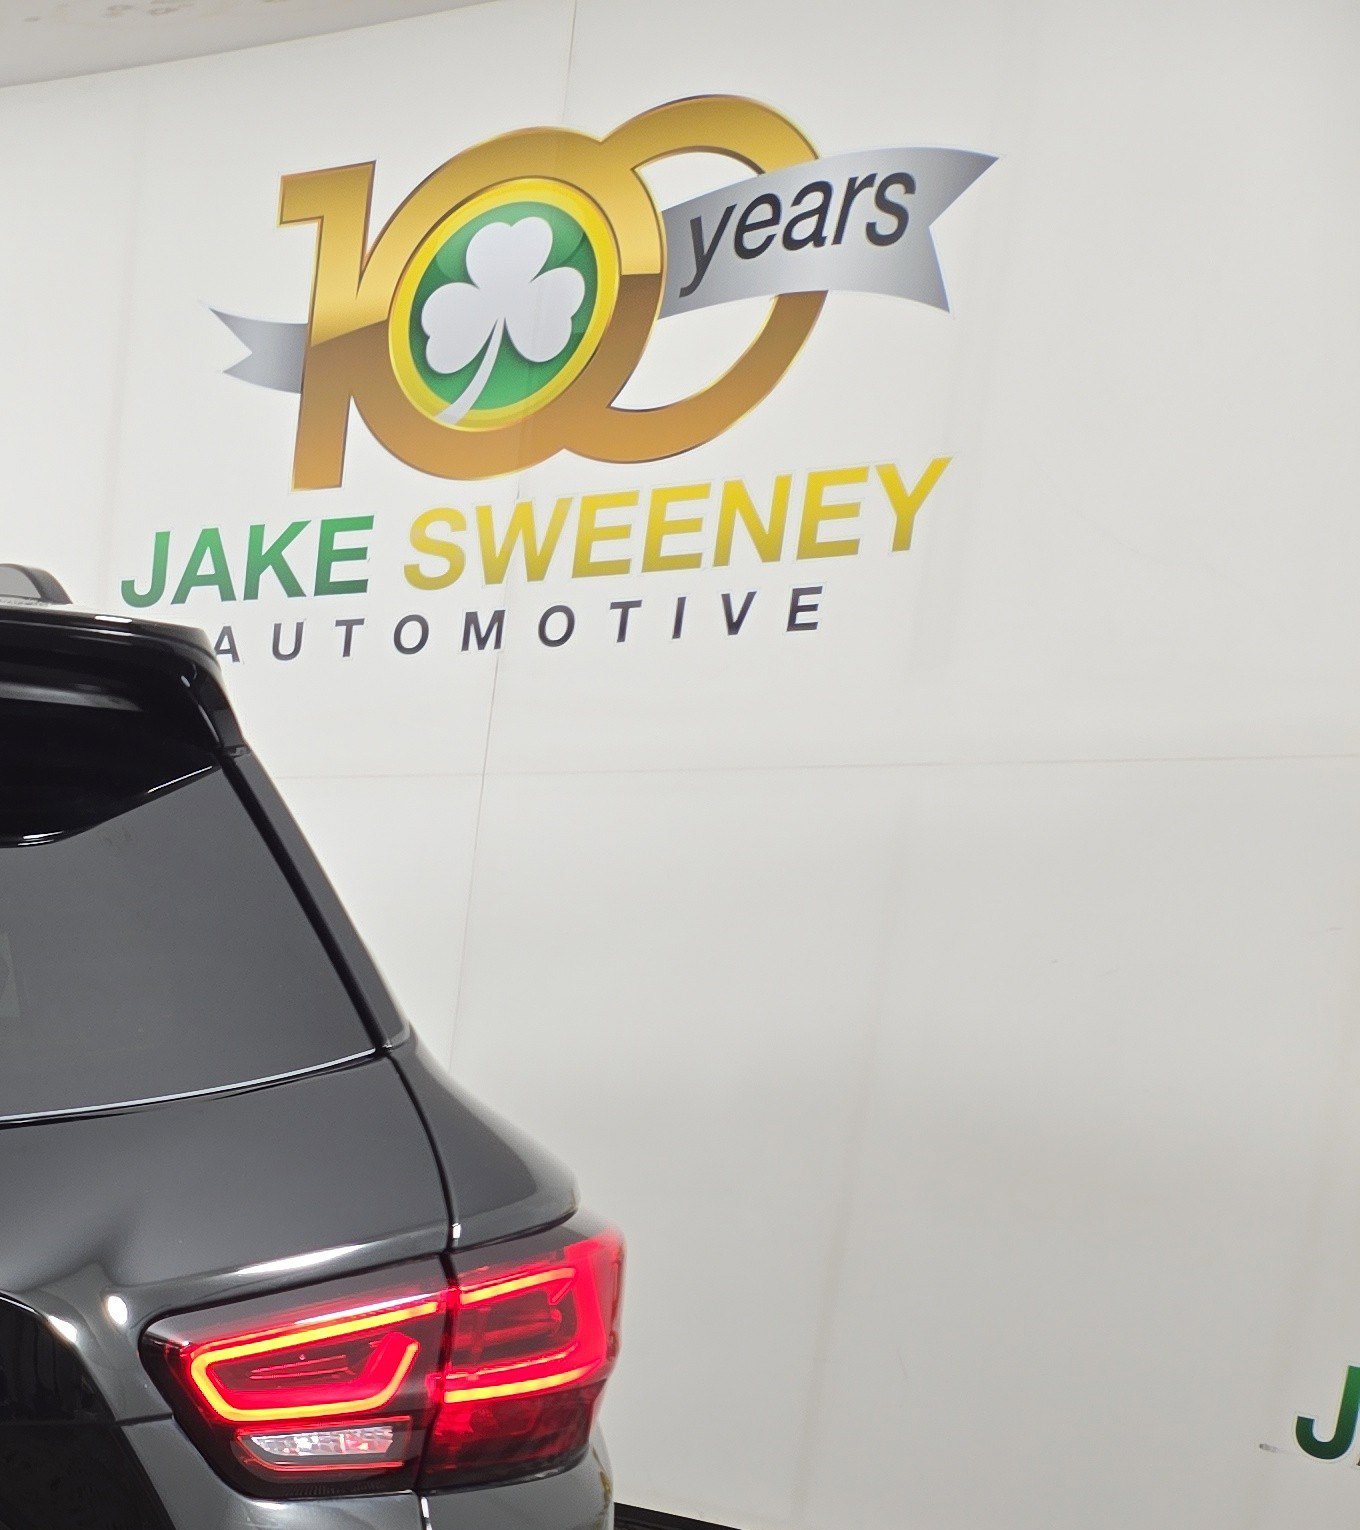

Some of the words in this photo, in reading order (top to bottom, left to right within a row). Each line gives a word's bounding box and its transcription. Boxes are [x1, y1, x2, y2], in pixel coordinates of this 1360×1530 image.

[276, 94, 829, 493] 100
[679, 170, 917, 298] years
[120, 514, 376, 609] JAKE
[402, 456, 953, 592] SWEENEY
[213, 585, 825, 664] AUTOMOTIVE
